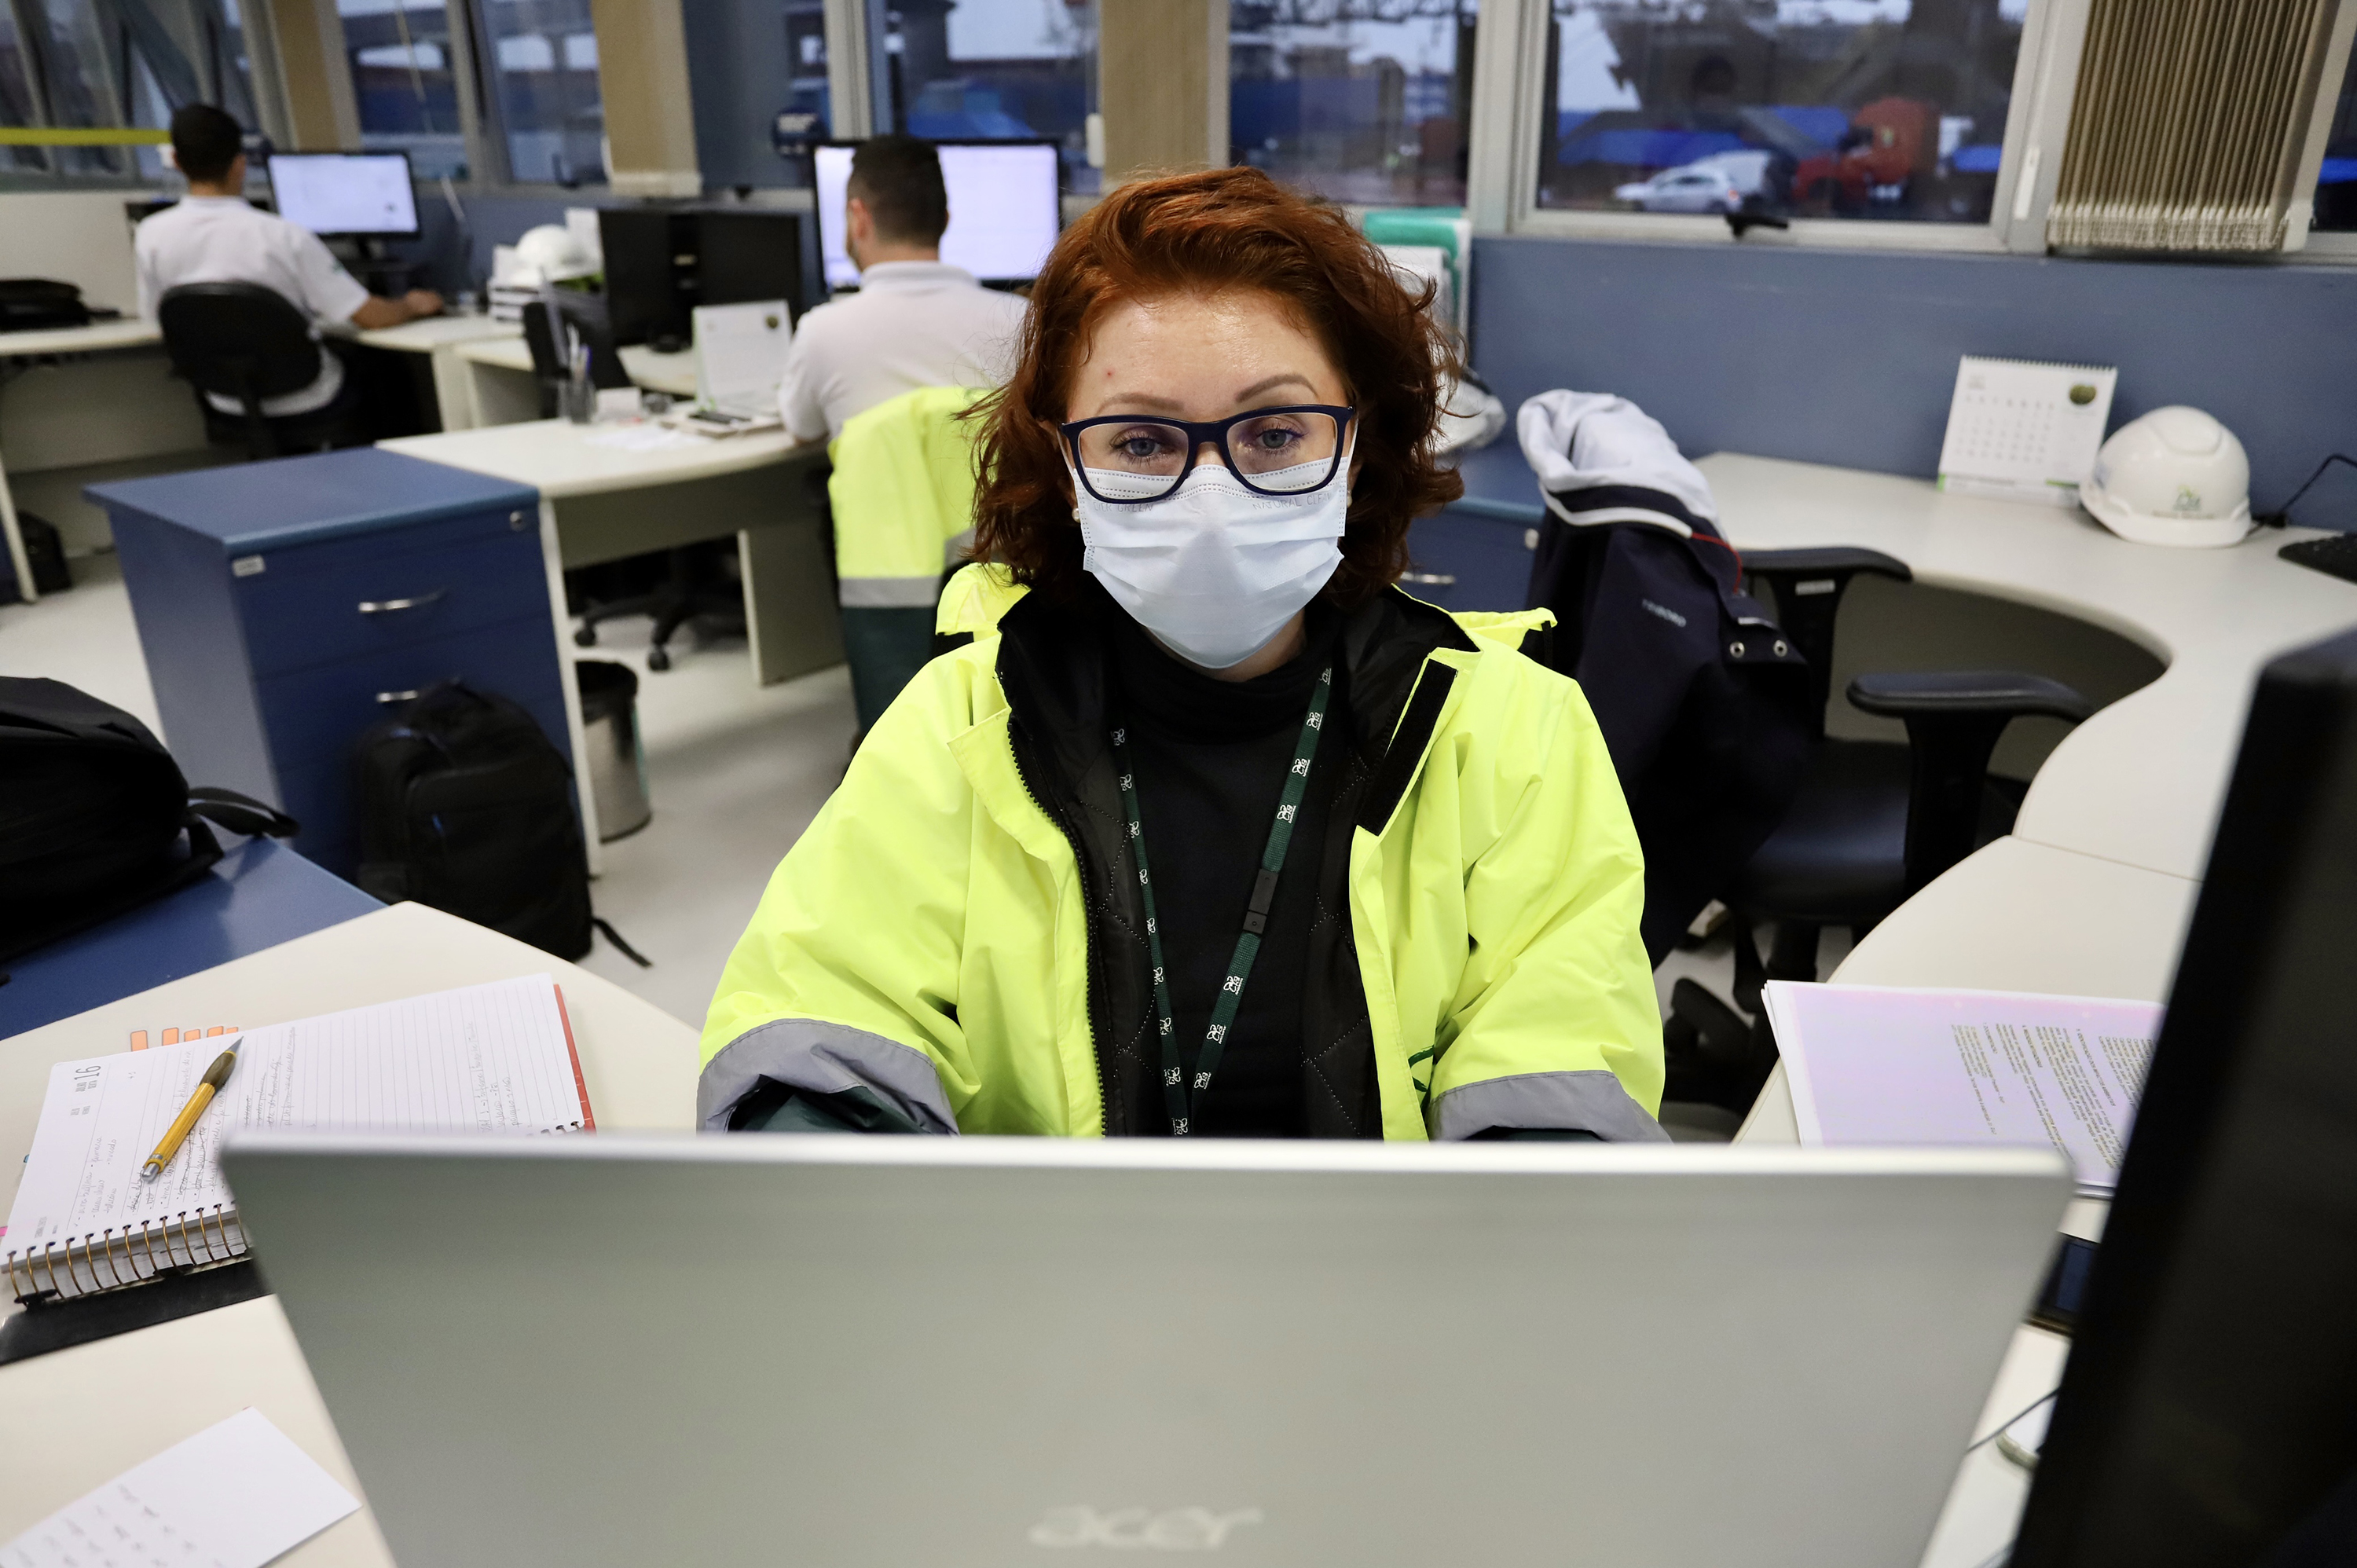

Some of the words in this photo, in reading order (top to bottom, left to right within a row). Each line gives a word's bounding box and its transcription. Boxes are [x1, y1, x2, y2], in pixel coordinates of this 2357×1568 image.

[1252, 498, 1302, 510] NATURAL
[74, 1065, 101, 1080] 16
[1027, 1504, 1264, 1550] acer
